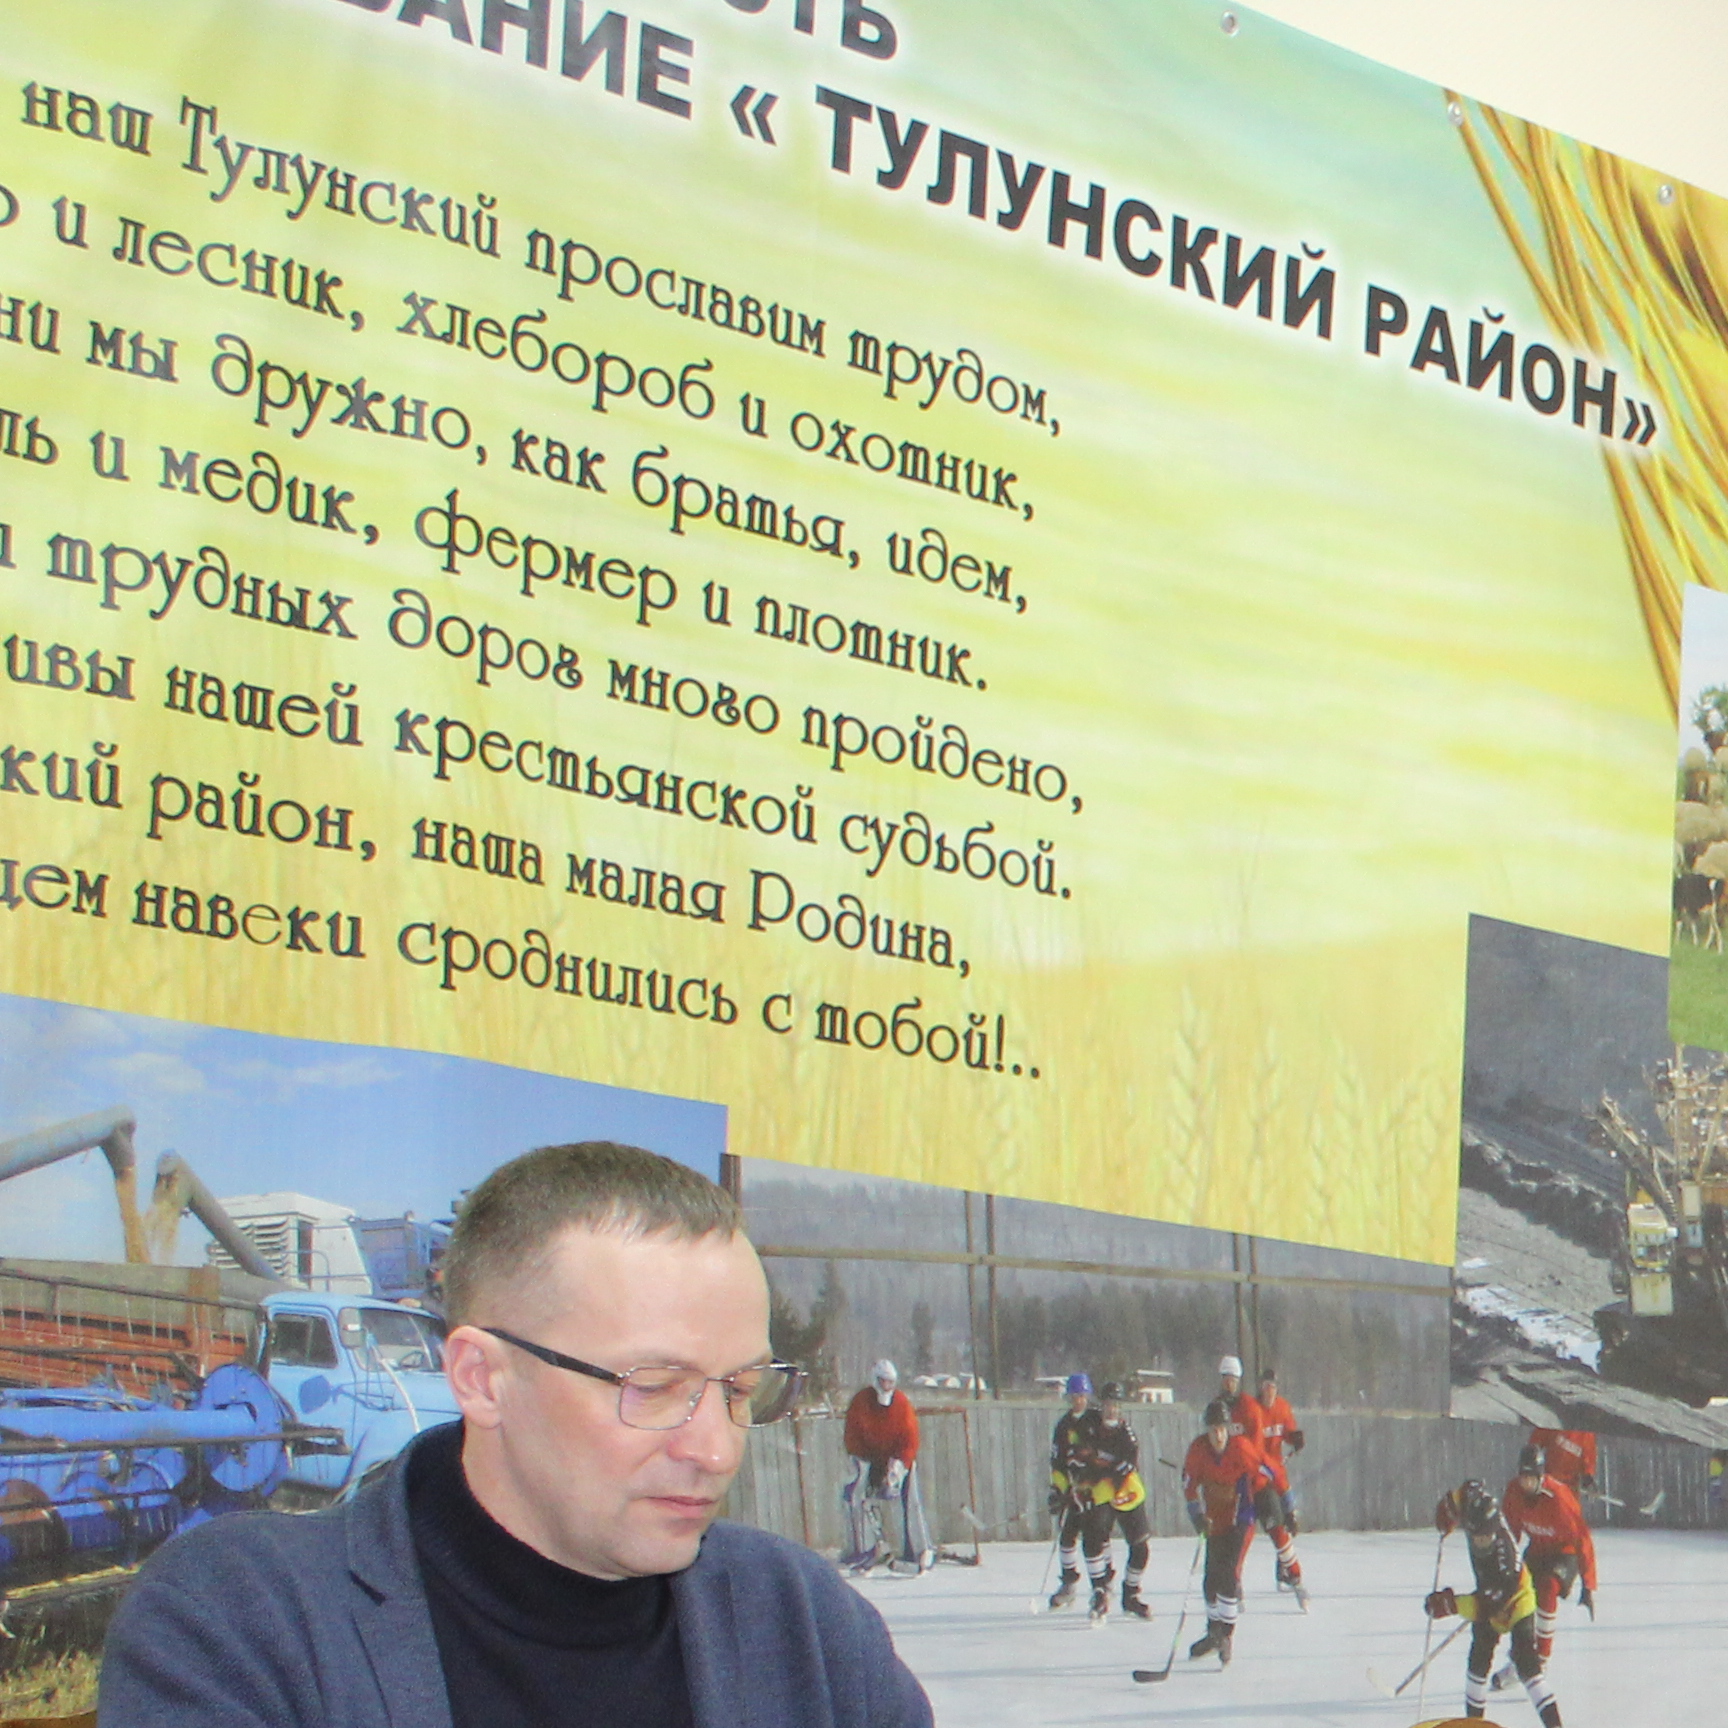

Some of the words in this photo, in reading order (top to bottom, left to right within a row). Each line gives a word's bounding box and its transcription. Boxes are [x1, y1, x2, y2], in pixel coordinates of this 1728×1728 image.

[20, 81, 154, 157] наш
[179, 94, 501, 259] Тулунский
[524, 227, 827, 359] прославим
[847, 329, 1060, 438] трудом,
[51, 195, 89, 250] и
[111, 216, 365, 333] лесник,
[395, 291, 716, 420] хлебороб
[739, 391, 768, 439] и
[789, 411, 1034, 522] охотник,
[337, 0, 694, 120] НИЕ
[815, 84, 1336, 341] ТУЛУНСКИЙ
[1364, 283, 1657, 447] РАЙОН»
[85, 320, 179, 383] мы
[210, 333, 487, 466] дружно,
[511, 427, 608, 494] как
[631, 444, 861, 570] братья,
[886, 527, 1027, 615] идем,
[89, 429, 130, 482] и
[158, 445, 380, 546] медик,
[414, 487, 678, 628] фермер
[702, 580, 732, 627] и
[754, 594, 987, 691] плотник.
[2, 633, 136, 702] ивы
[163, 664, 364, 747] нашей
[393, 707, 818, 845] крестьянской
[839, 810, 1072, 900] судьбой.
[46, 532, 359, 640] трудных
[387, 587, 584, 690] дорог
[606, 658, 780, 735] много
[800, 705, 1083, 815] пройдено,
[0, 740, 124, 810] кий
[145, 770, 377, 863] район,
[410, 816, 546, 887] наша
[564, 852, 727, 924] малая
[746, 868, 971, 979] Родина,
[131, 879, 367, 959] навеки
[397, 921, 739, 1026] сроднились
[761, 993, 793, 1035] с
[813, 995, 1041, 1080] тобой!..
